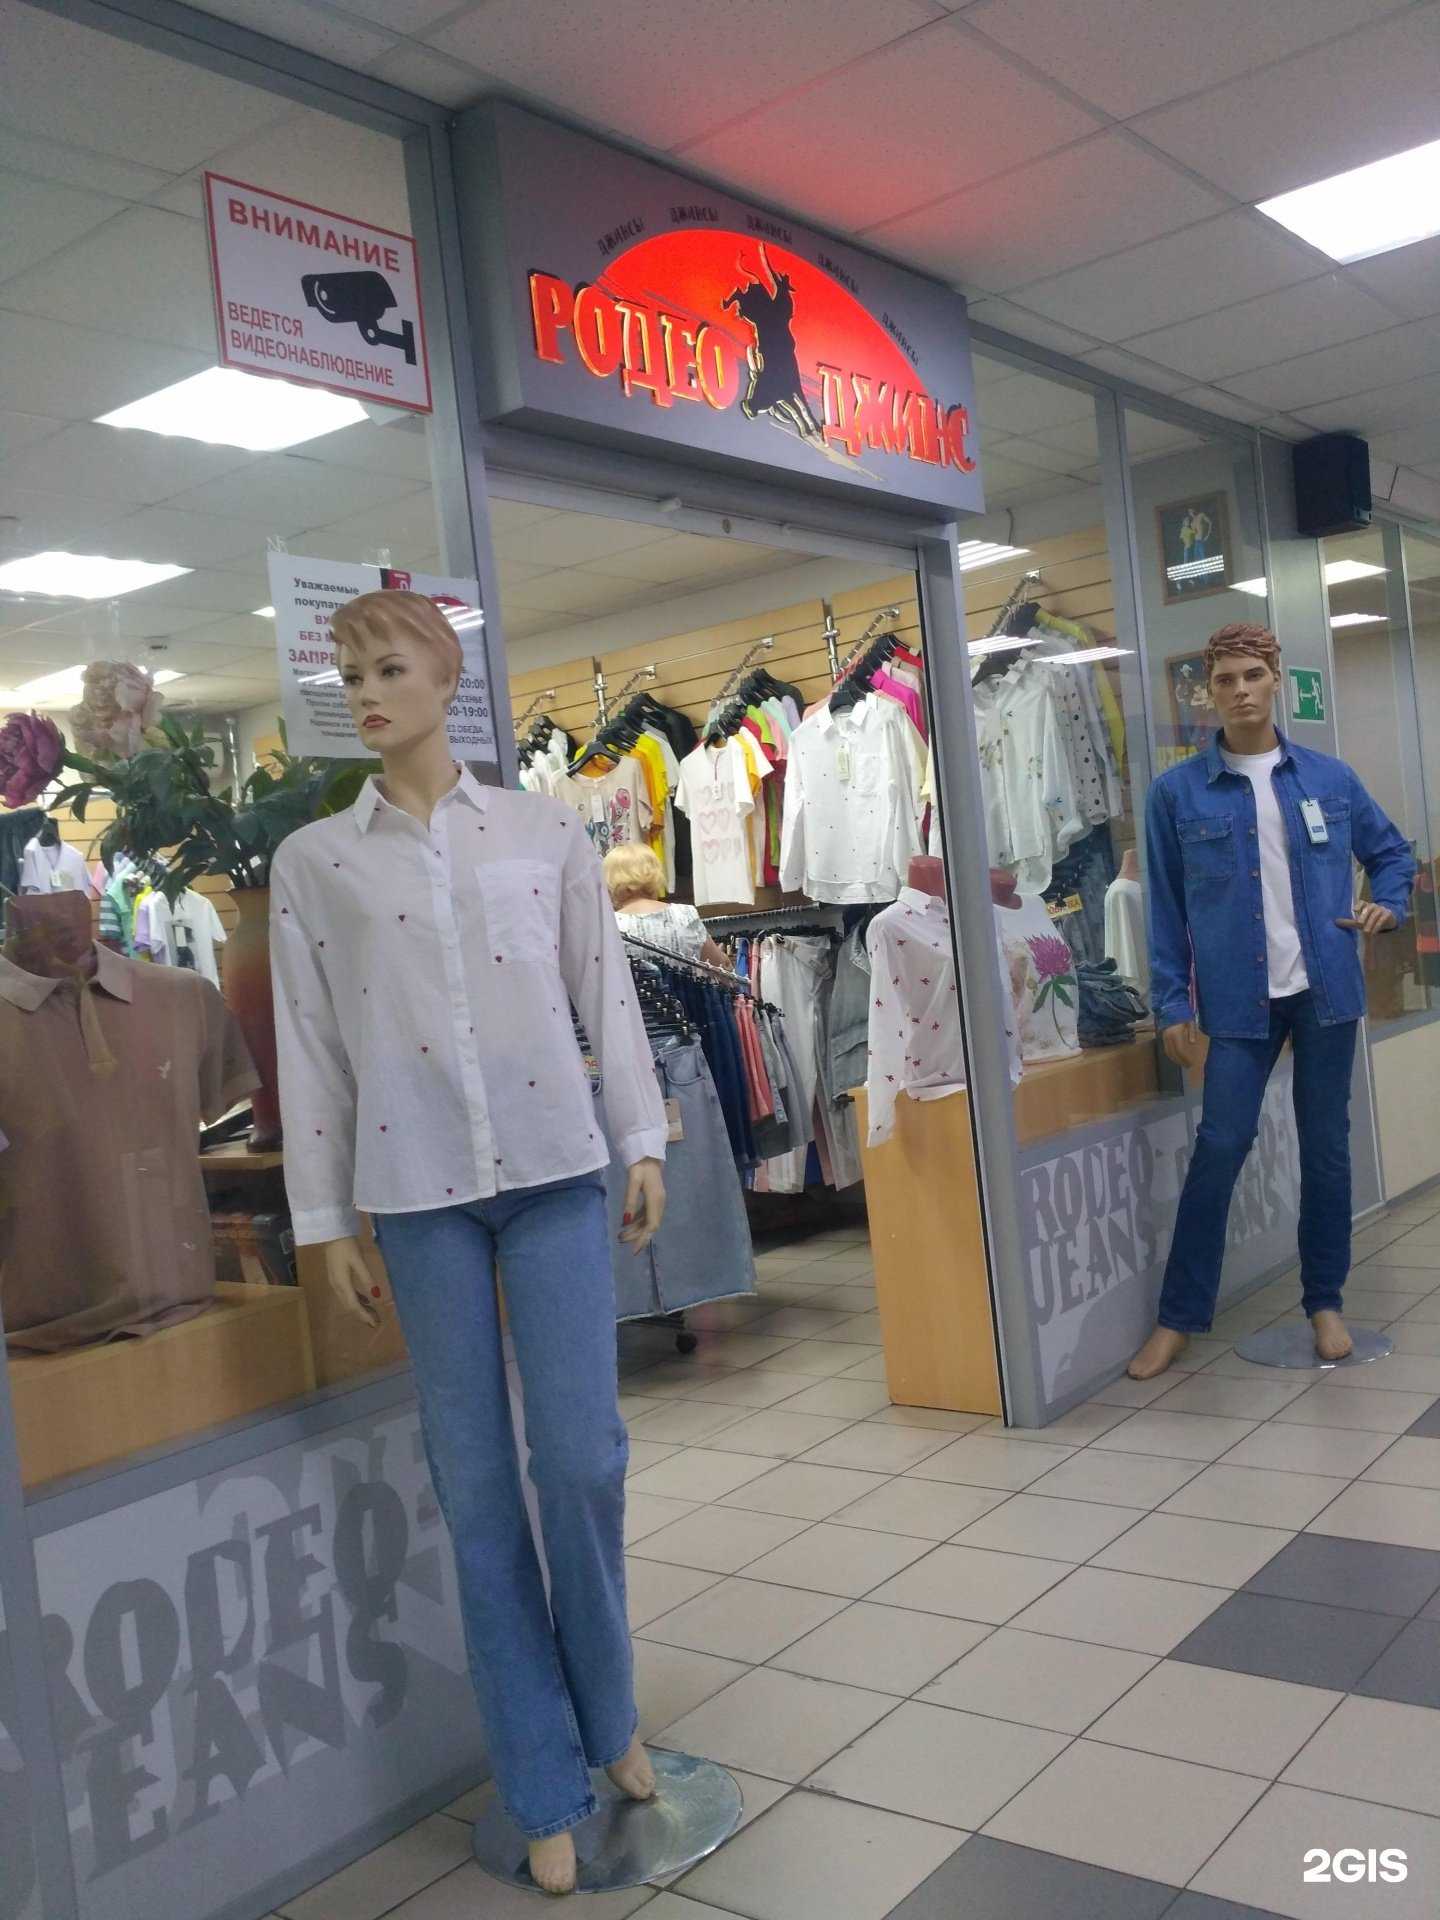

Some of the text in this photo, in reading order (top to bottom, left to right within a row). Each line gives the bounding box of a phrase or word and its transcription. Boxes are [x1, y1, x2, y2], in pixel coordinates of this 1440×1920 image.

[228, 198, 400, 272] ВНИМАНИЕ
[227, 302, 304, 338] ВЕДЕТСЯ
[231, 330, 394, 386] ВИДЕОНАБЛЮДЕНИЕ
[529, 270, 976, 474] РОДЕО ДЖИНС
[294, 576, 359, 595] Уважаемые
[295, 597, 345, 610] покупат
[299, 630, 322, 642] БЕЗ
[288, 648, 337, 667] ЗАПРЕ
[459, 677, 486, 690] 20:00
